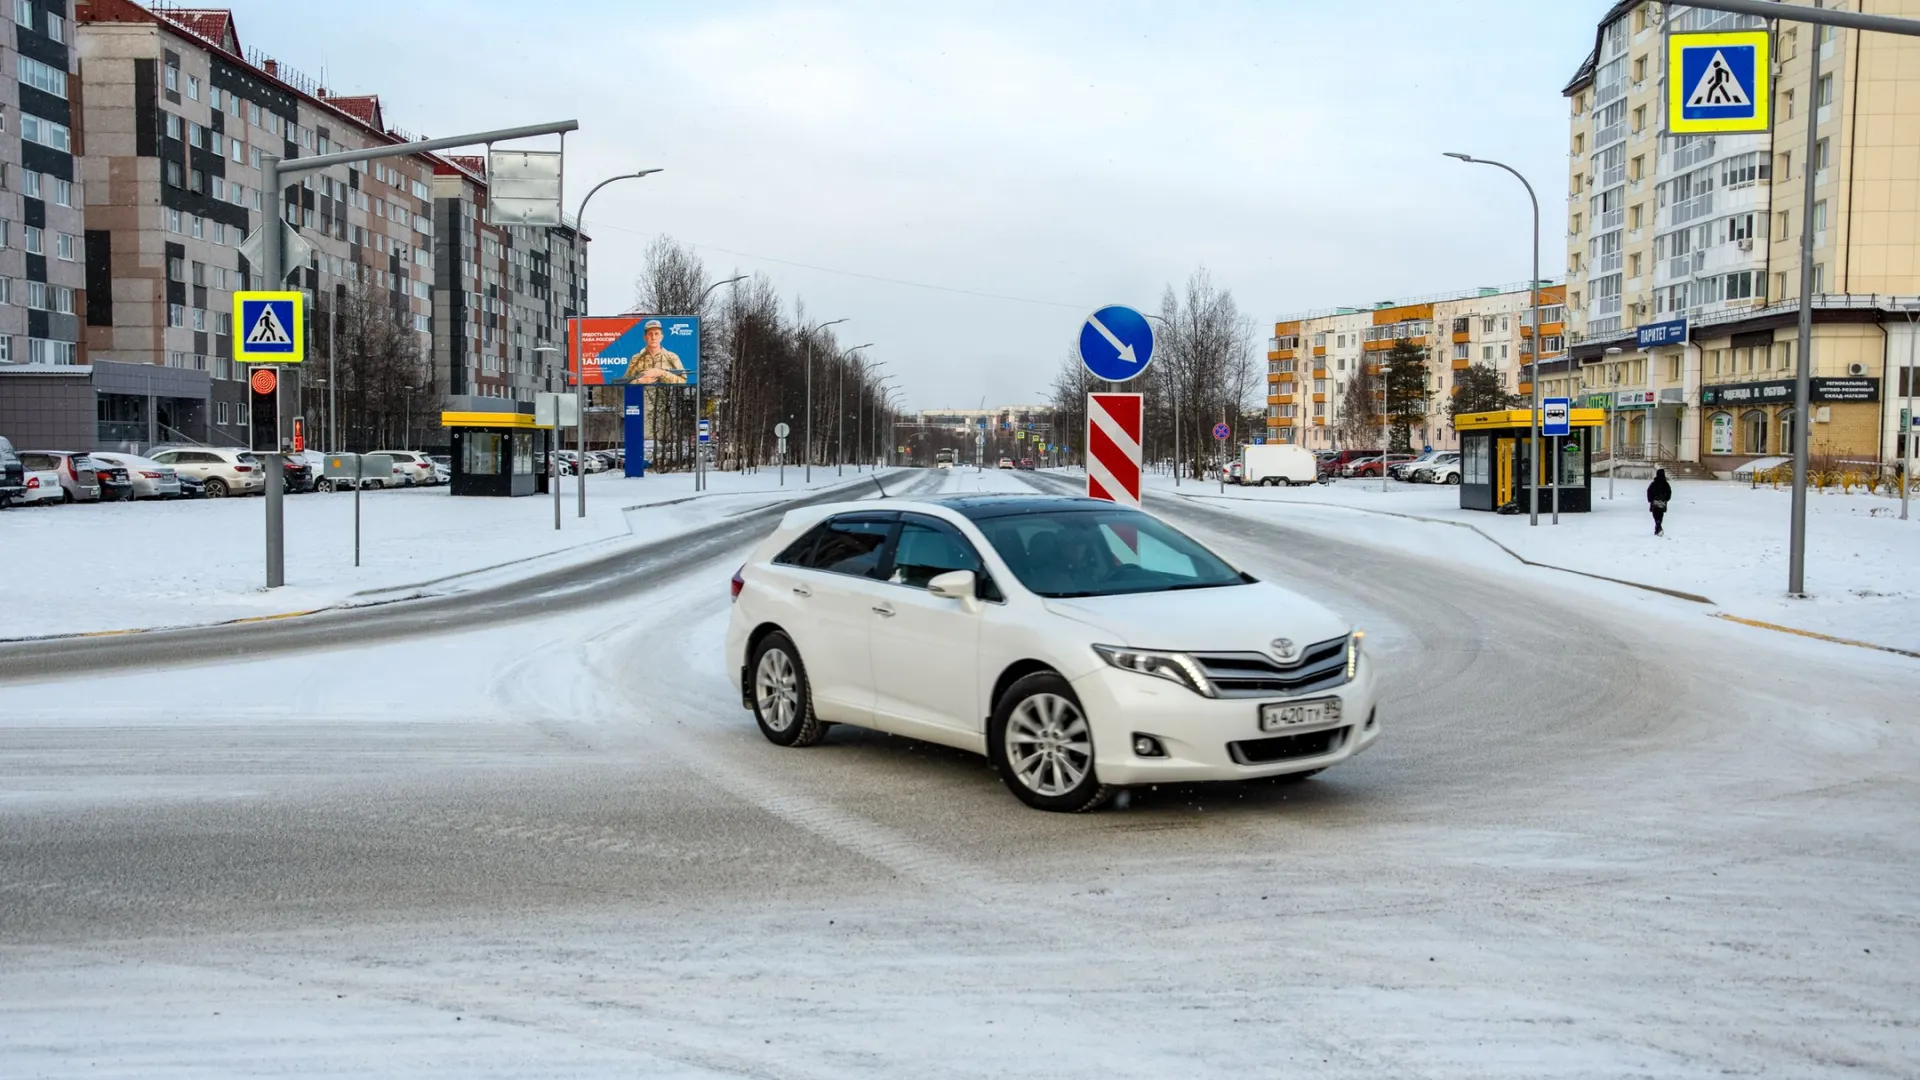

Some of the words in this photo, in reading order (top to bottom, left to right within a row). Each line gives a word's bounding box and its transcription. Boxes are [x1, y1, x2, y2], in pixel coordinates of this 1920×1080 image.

[1640, 326, 1667, 344] ПАРИТЕТ
[1723, 388, 1751, 400] ОДЕЖДА
[1754, 387, 1760, 398] &
[1763, 386, 1787, 397] ОБУВЬ
[1586, 395, 1612, 409] АПТЕКА
